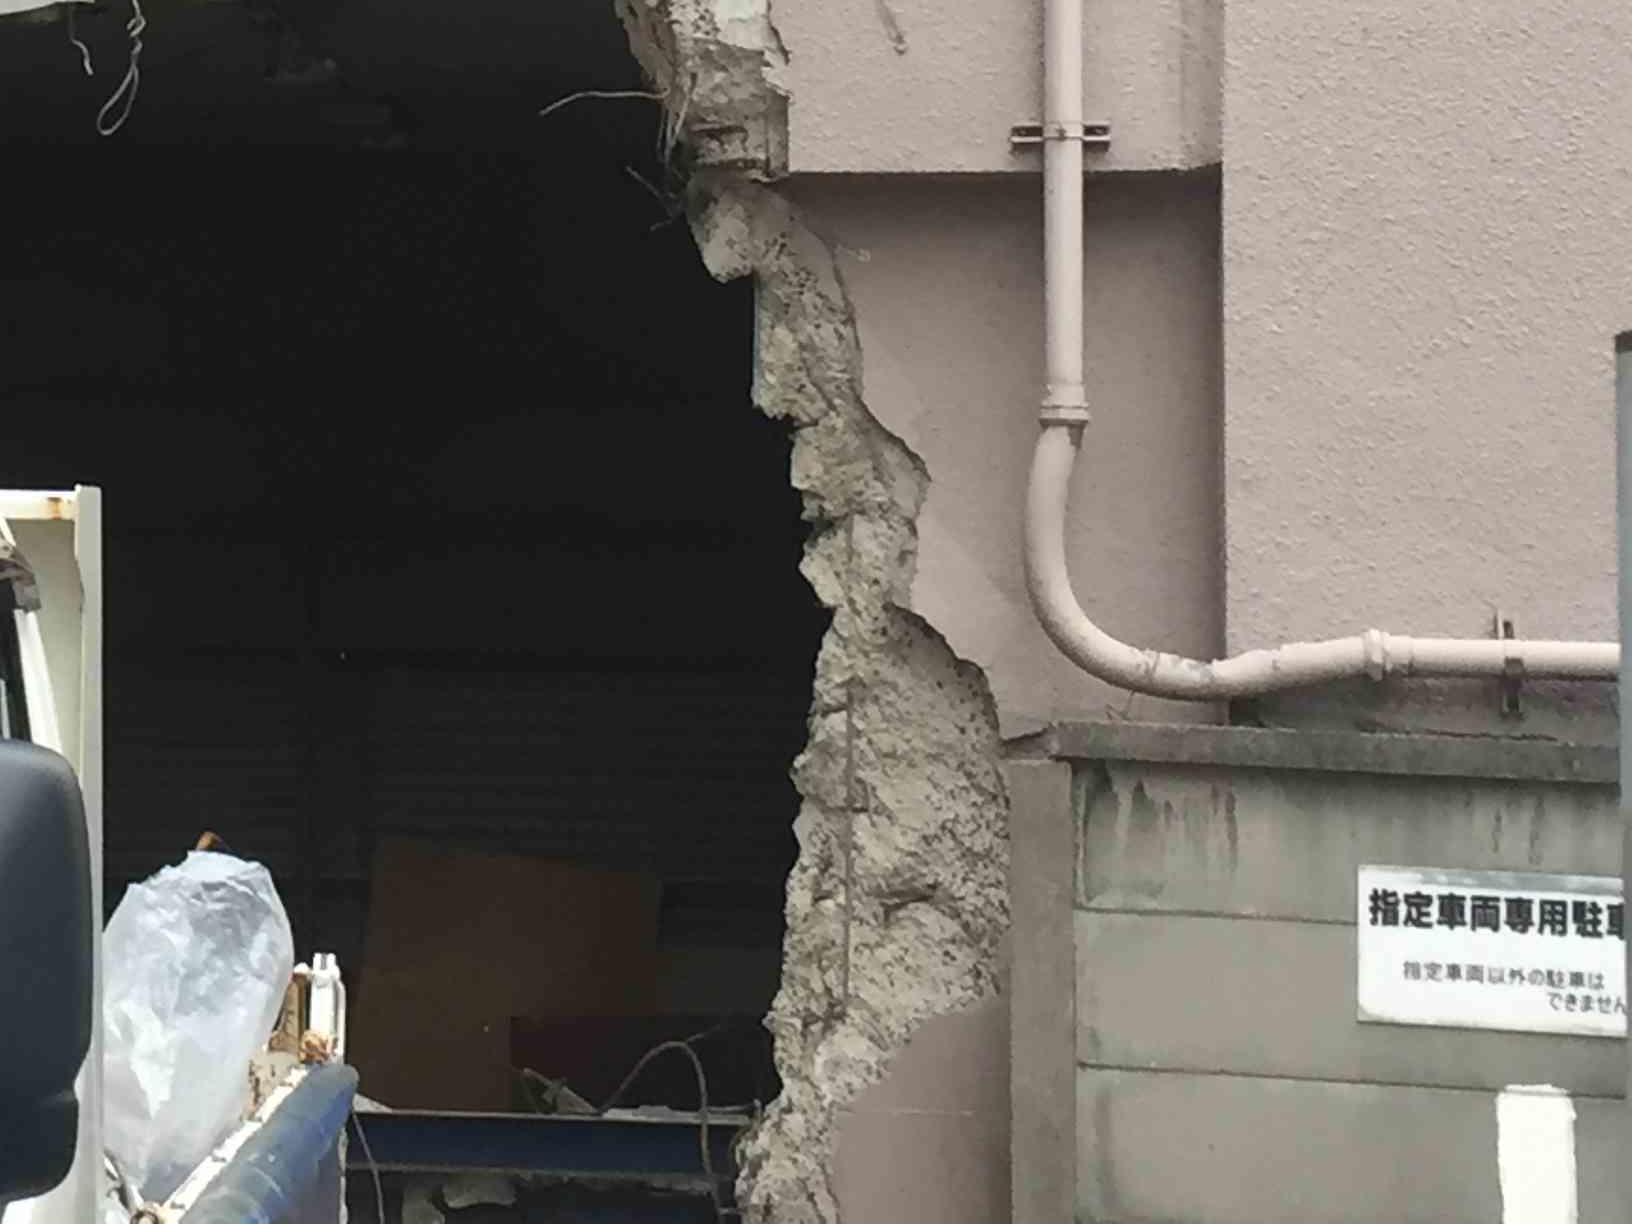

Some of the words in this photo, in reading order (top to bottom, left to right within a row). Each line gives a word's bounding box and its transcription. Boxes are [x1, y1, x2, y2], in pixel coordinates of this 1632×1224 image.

[1402, 960, 1605, 991] 指定車両以外の駐車は
